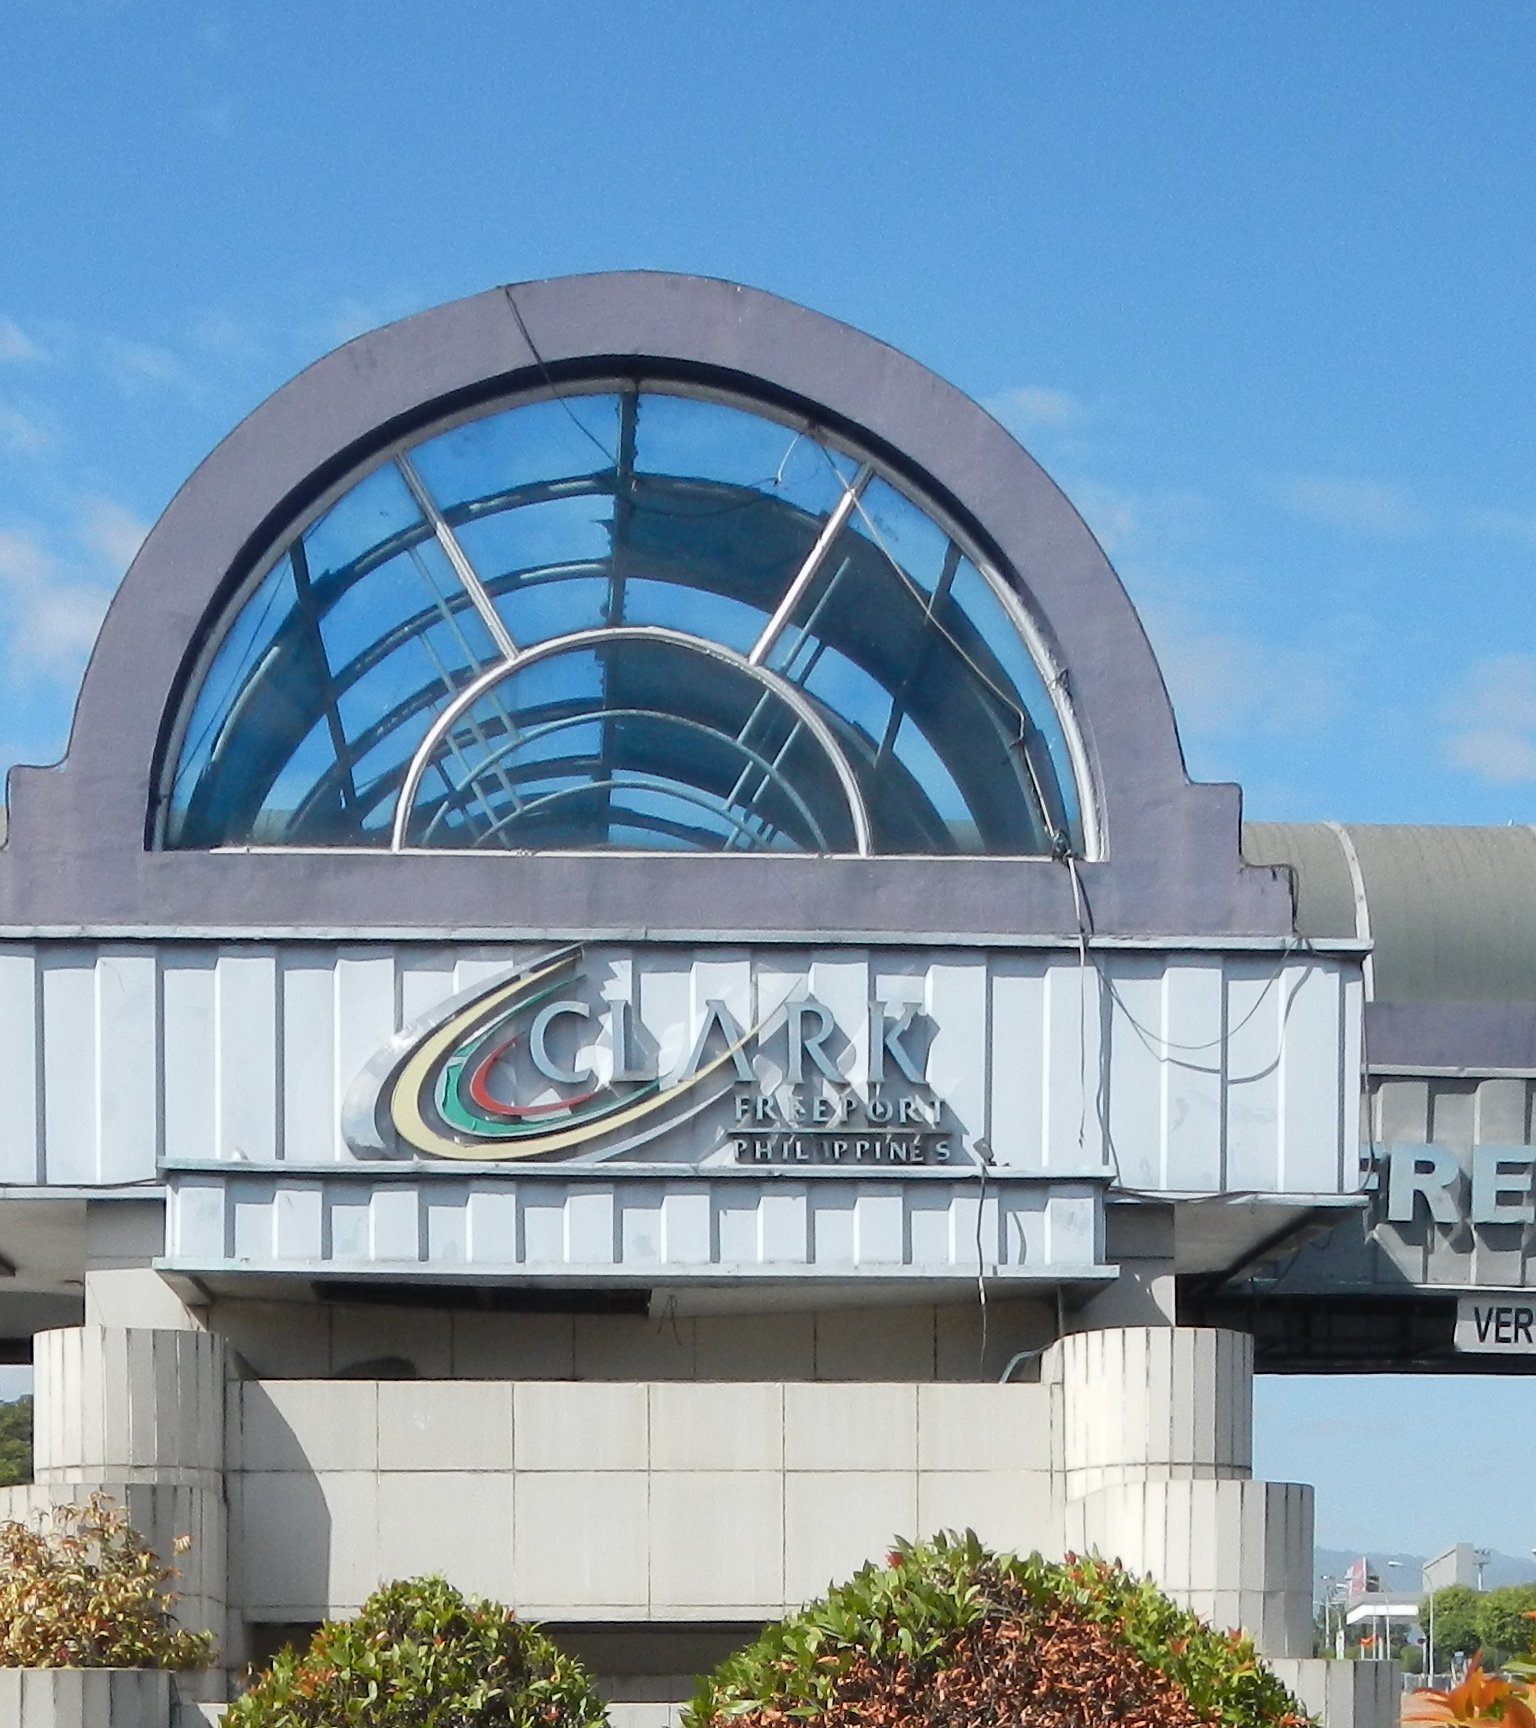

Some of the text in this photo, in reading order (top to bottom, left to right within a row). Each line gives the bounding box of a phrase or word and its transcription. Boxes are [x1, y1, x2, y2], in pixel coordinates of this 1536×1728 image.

[529, 999, 929, 1086] CLARK
[734, 1095, 945, 1124] FREEPORT
[734, 1139, 952, 1162] PHILIPPINES
